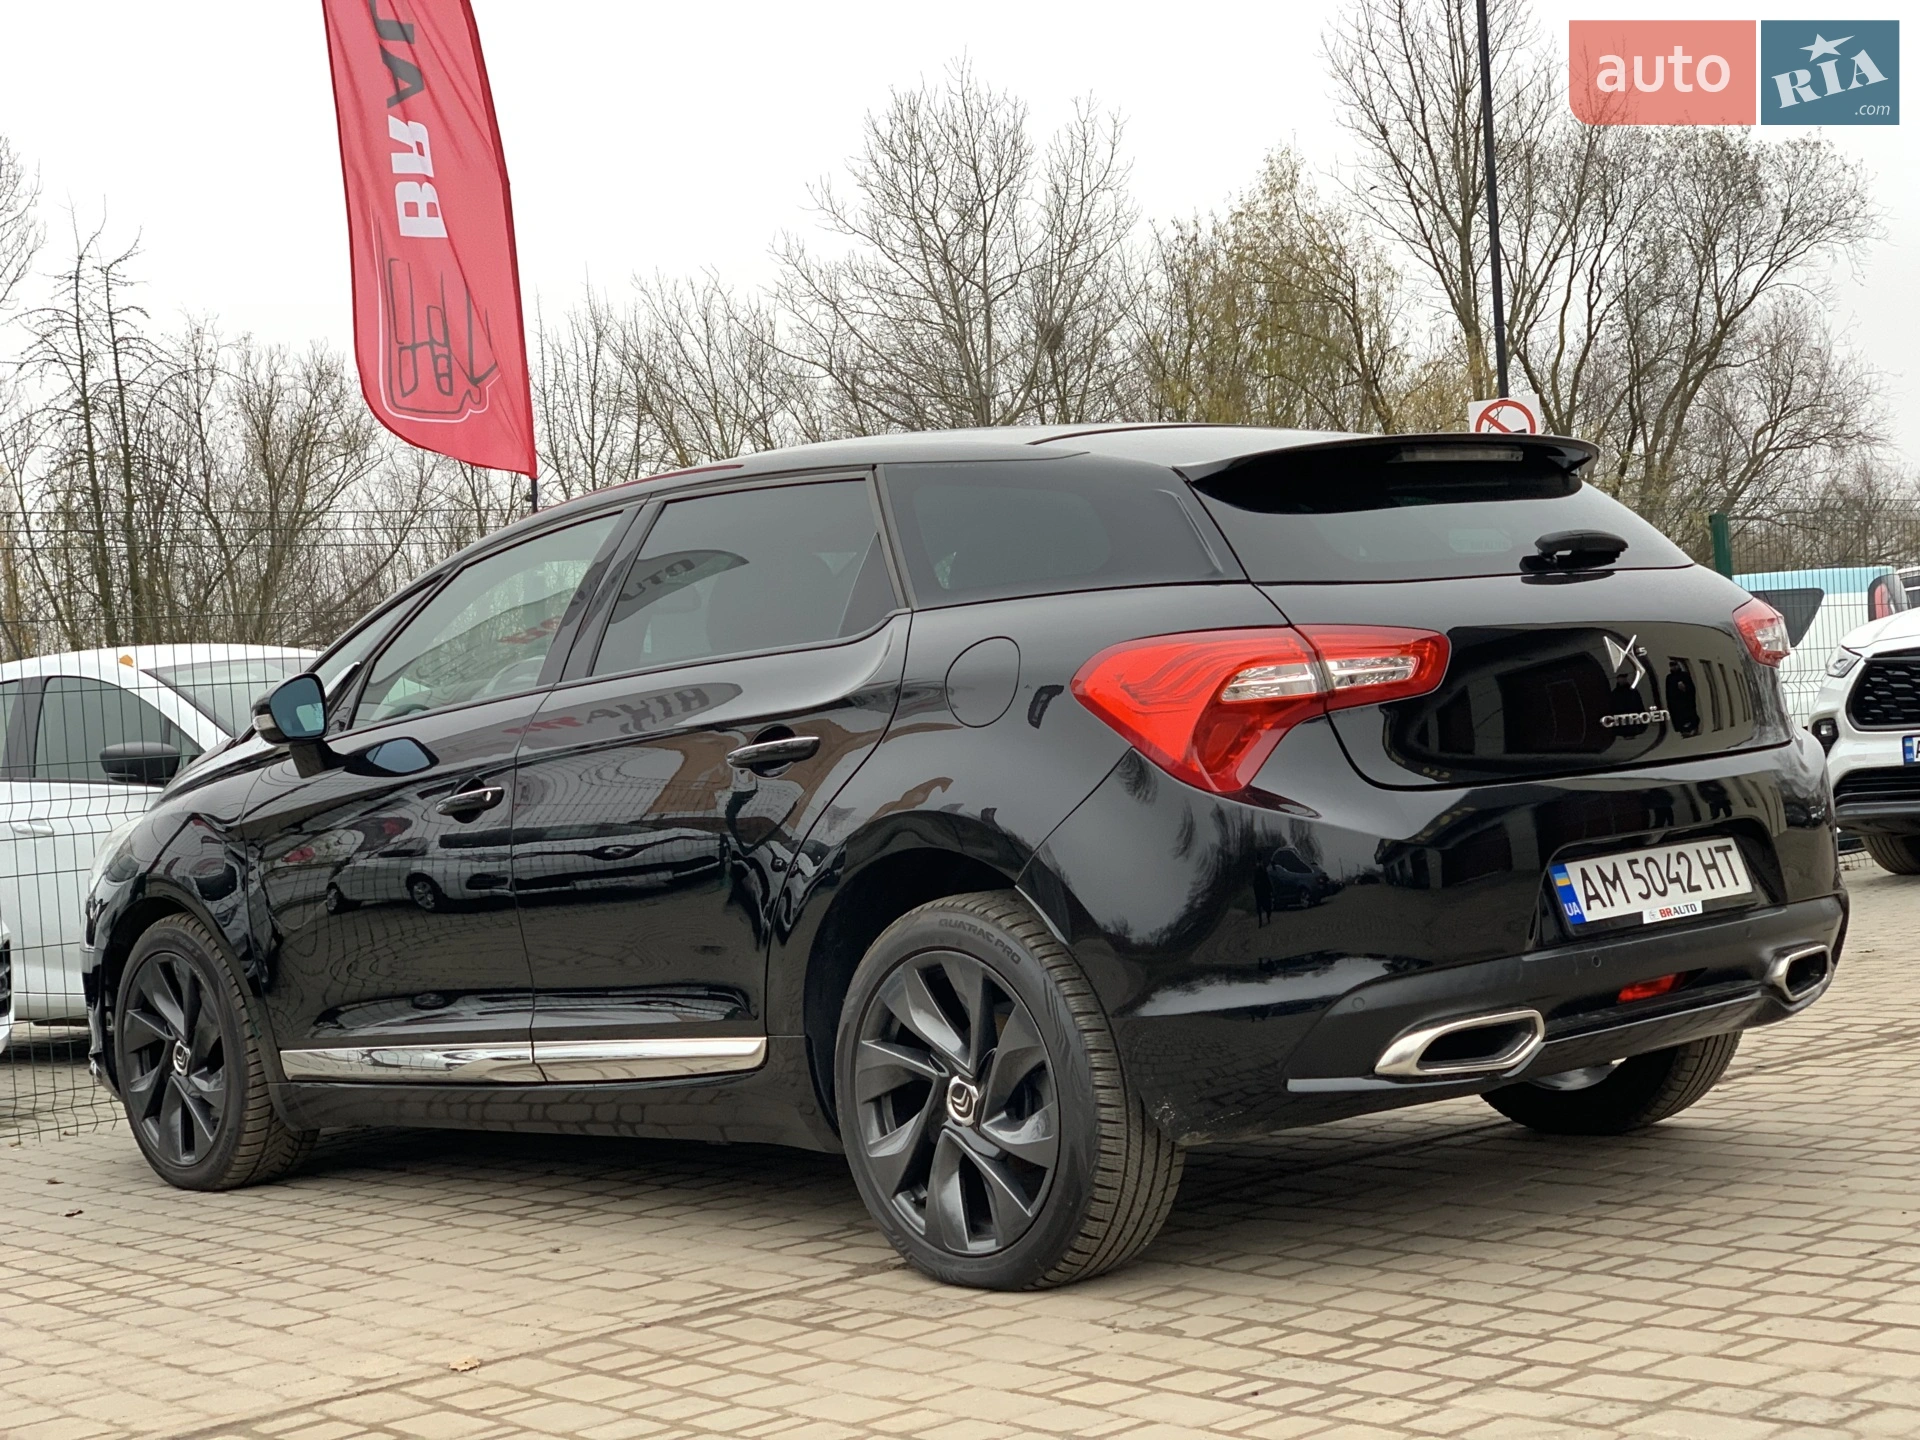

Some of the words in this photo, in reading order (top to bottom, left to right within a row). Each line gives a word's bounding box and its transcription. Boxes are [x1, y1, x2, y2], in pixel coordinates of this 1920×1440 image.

[1580, 861, 1632, 912] AM
[1626, 851, 1703, 900] 5042
[1696, 844, 1740, 890] HT
[1564, 901, 1582, 917] UA
[994, 938, 1022, 965] PRO
